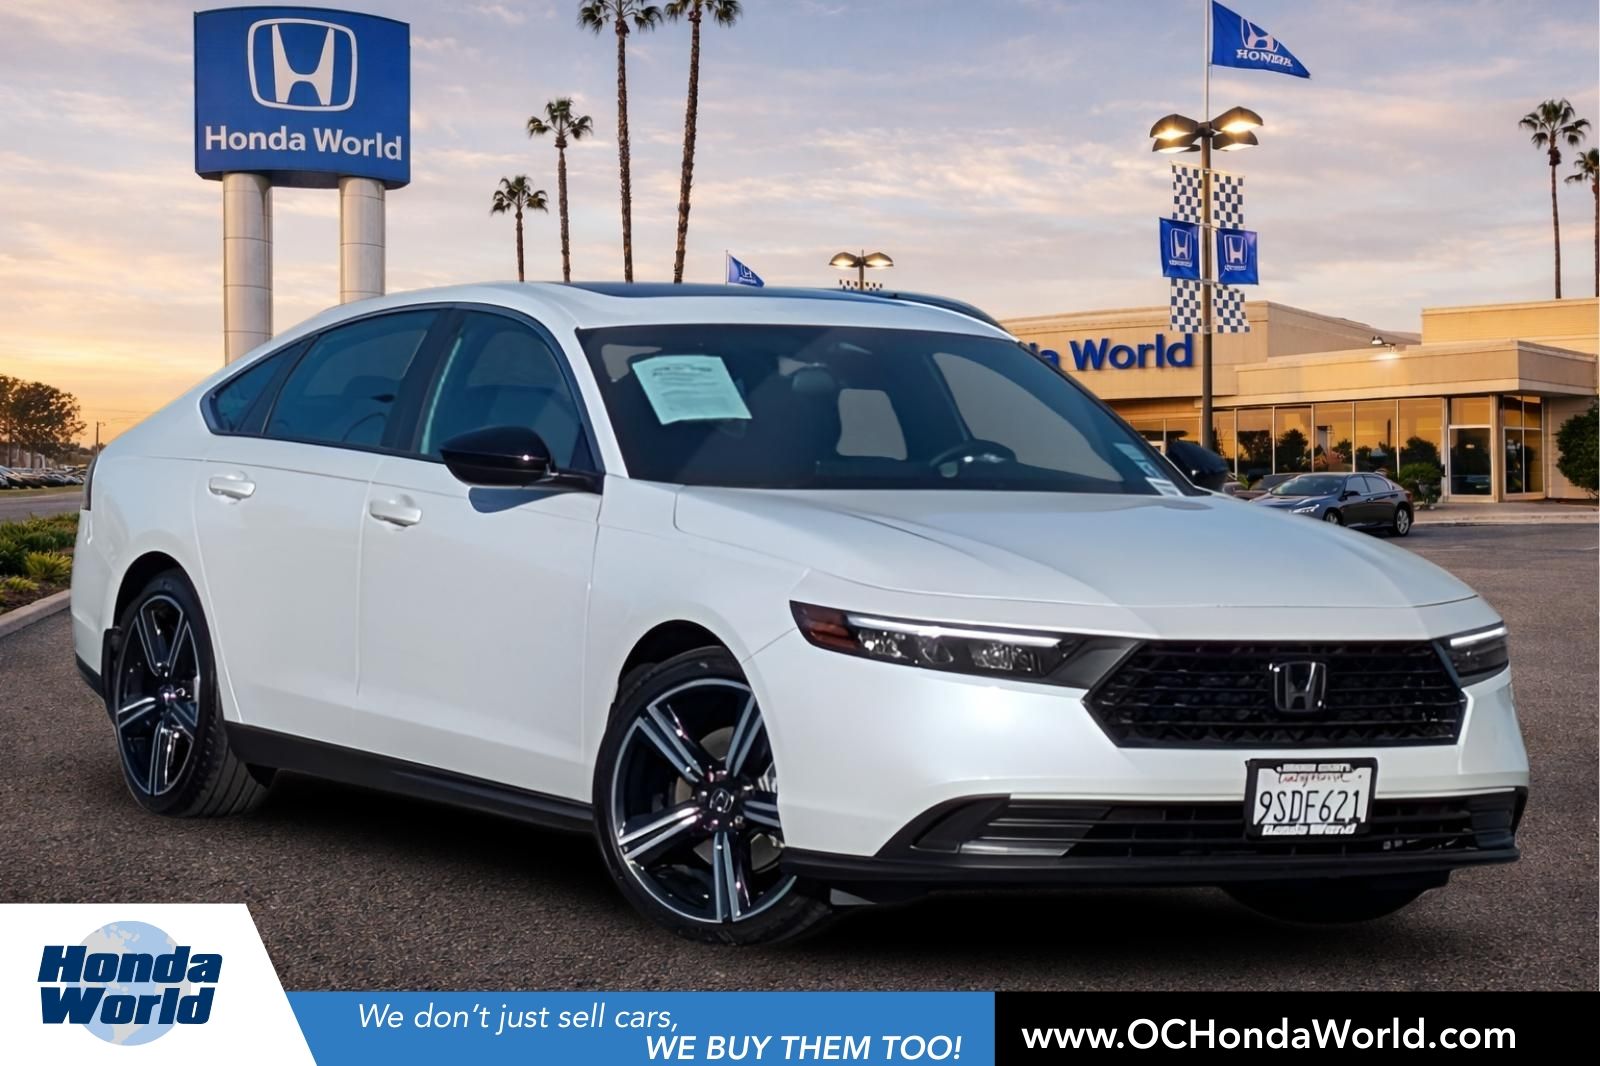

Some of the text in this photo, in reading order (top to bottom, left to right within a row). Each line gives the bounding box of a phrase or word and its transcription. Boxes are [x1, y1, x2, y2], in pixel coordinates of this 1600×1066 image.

[205, 125, 402, 160] Honda World
[1069, 333, 1194, 371] World
[1257, 790, 1361, 824] 9SDF621
